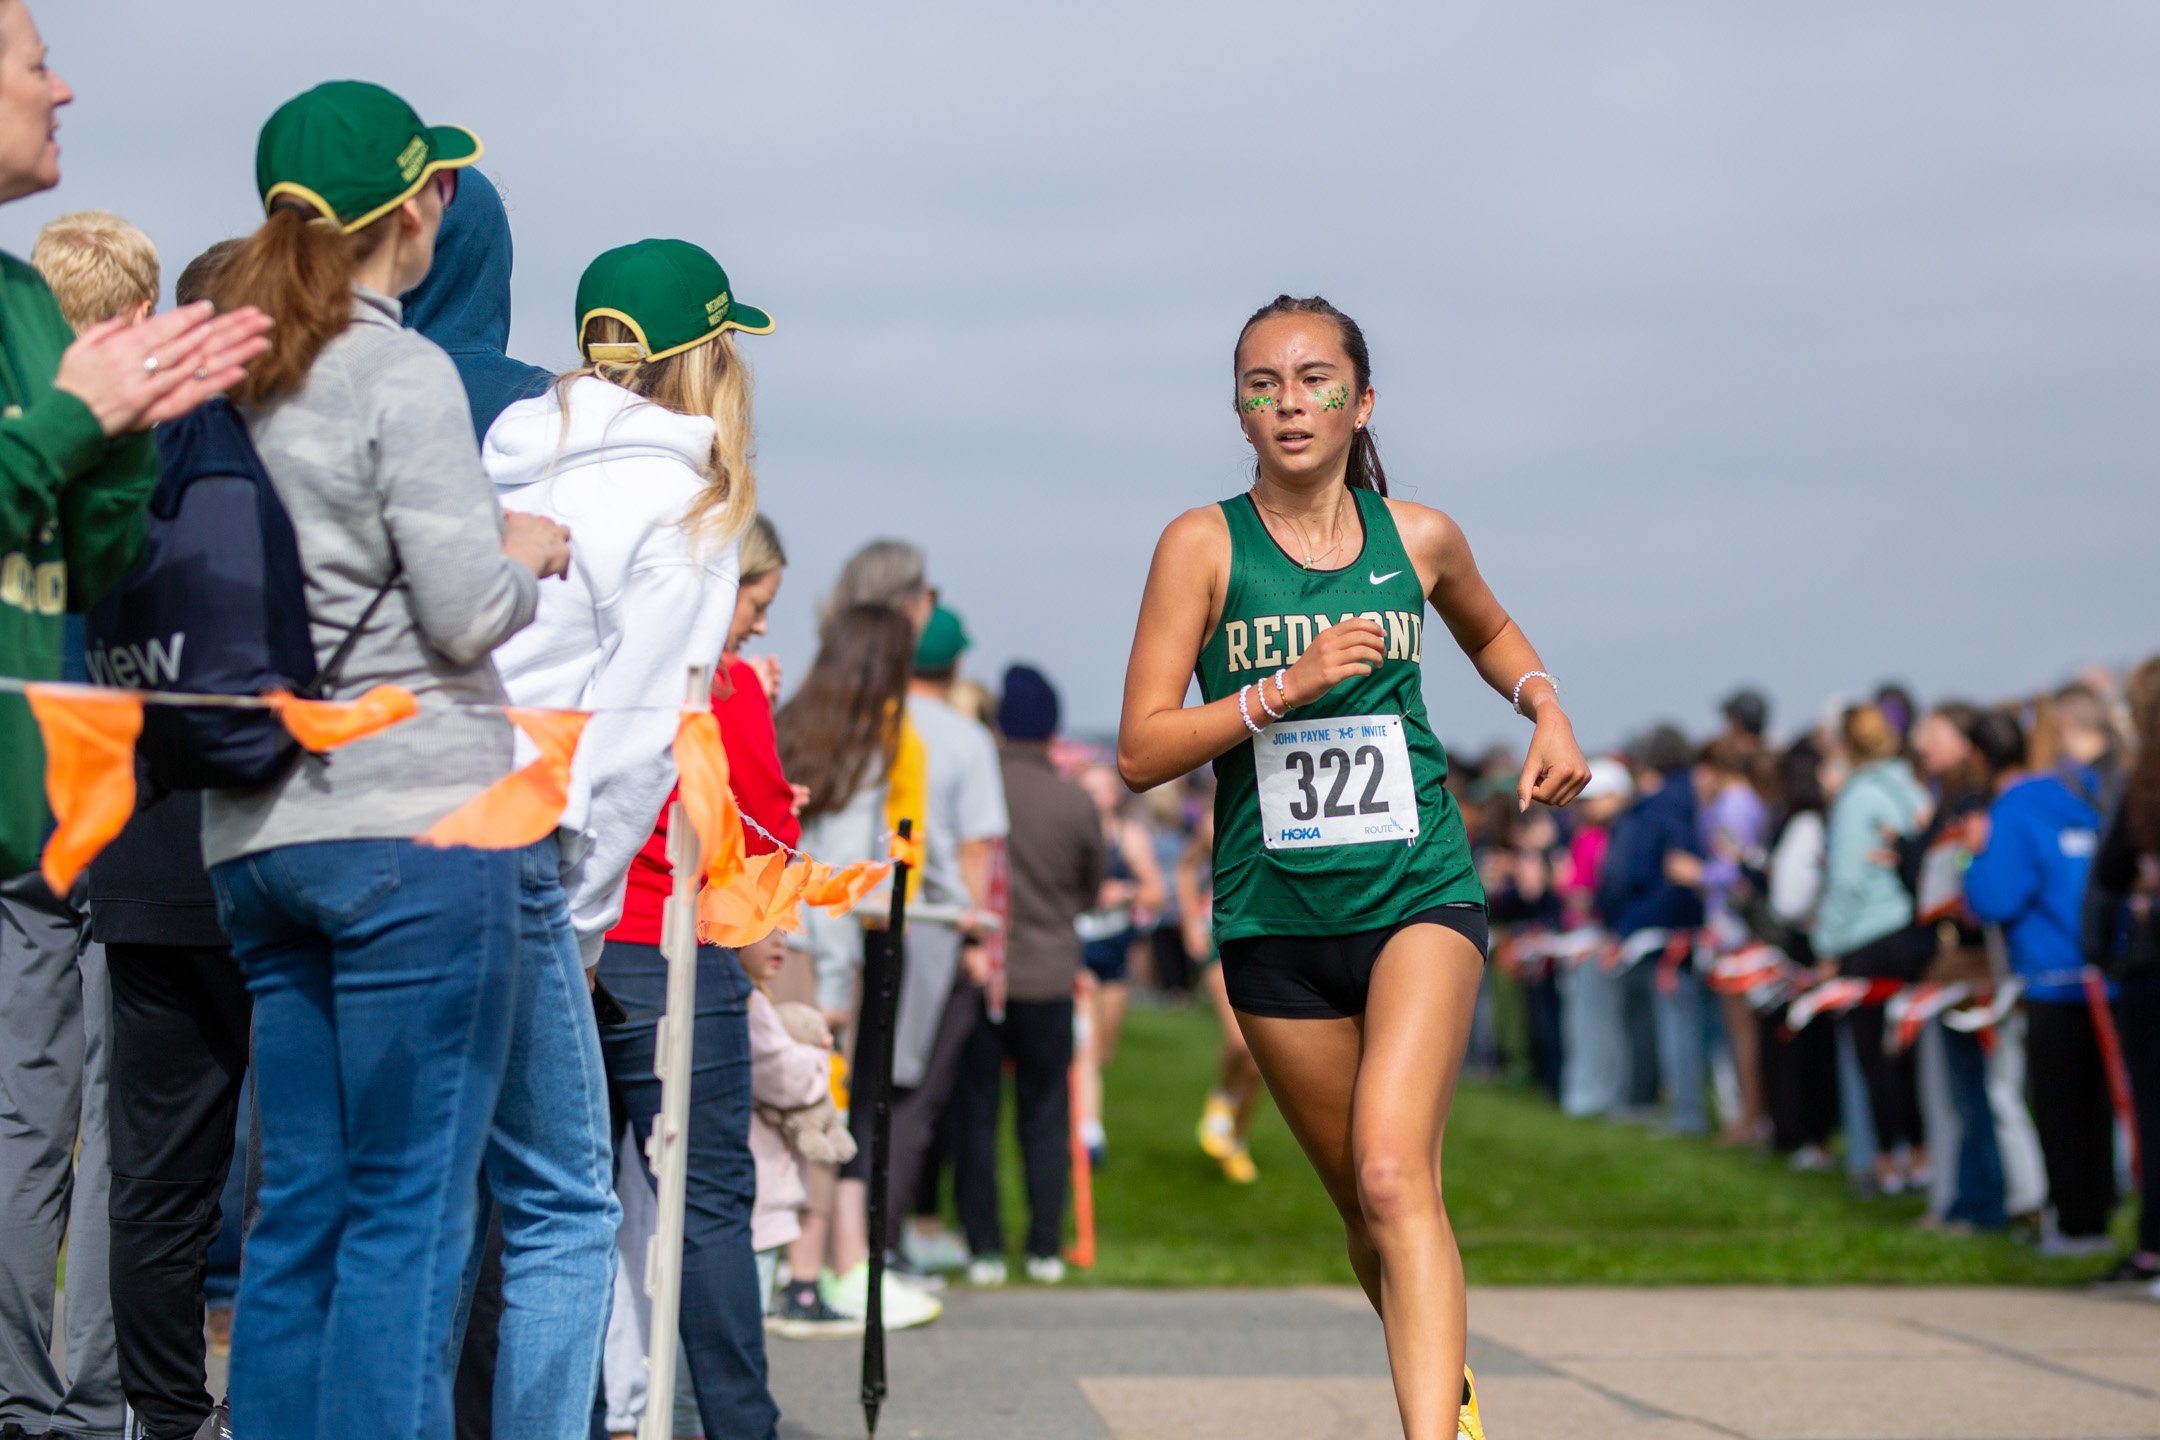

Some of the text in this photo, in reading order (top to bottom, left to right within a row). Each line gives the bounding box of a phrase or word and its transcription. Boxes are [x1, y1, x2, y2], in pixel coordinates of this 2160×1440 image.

[1225, 610, 1422, 672] REDND
[1273, 732, 1298, 745] JOHN
[1301, 729, 1331, 743] PAYNE
[1361, 726, 1387, 738] INVITE
[1286, 745, 1390, 821] 322
[1281, 827, 1321, 841] HOKA
[1364, 824, 1393, 834] ROUTE
